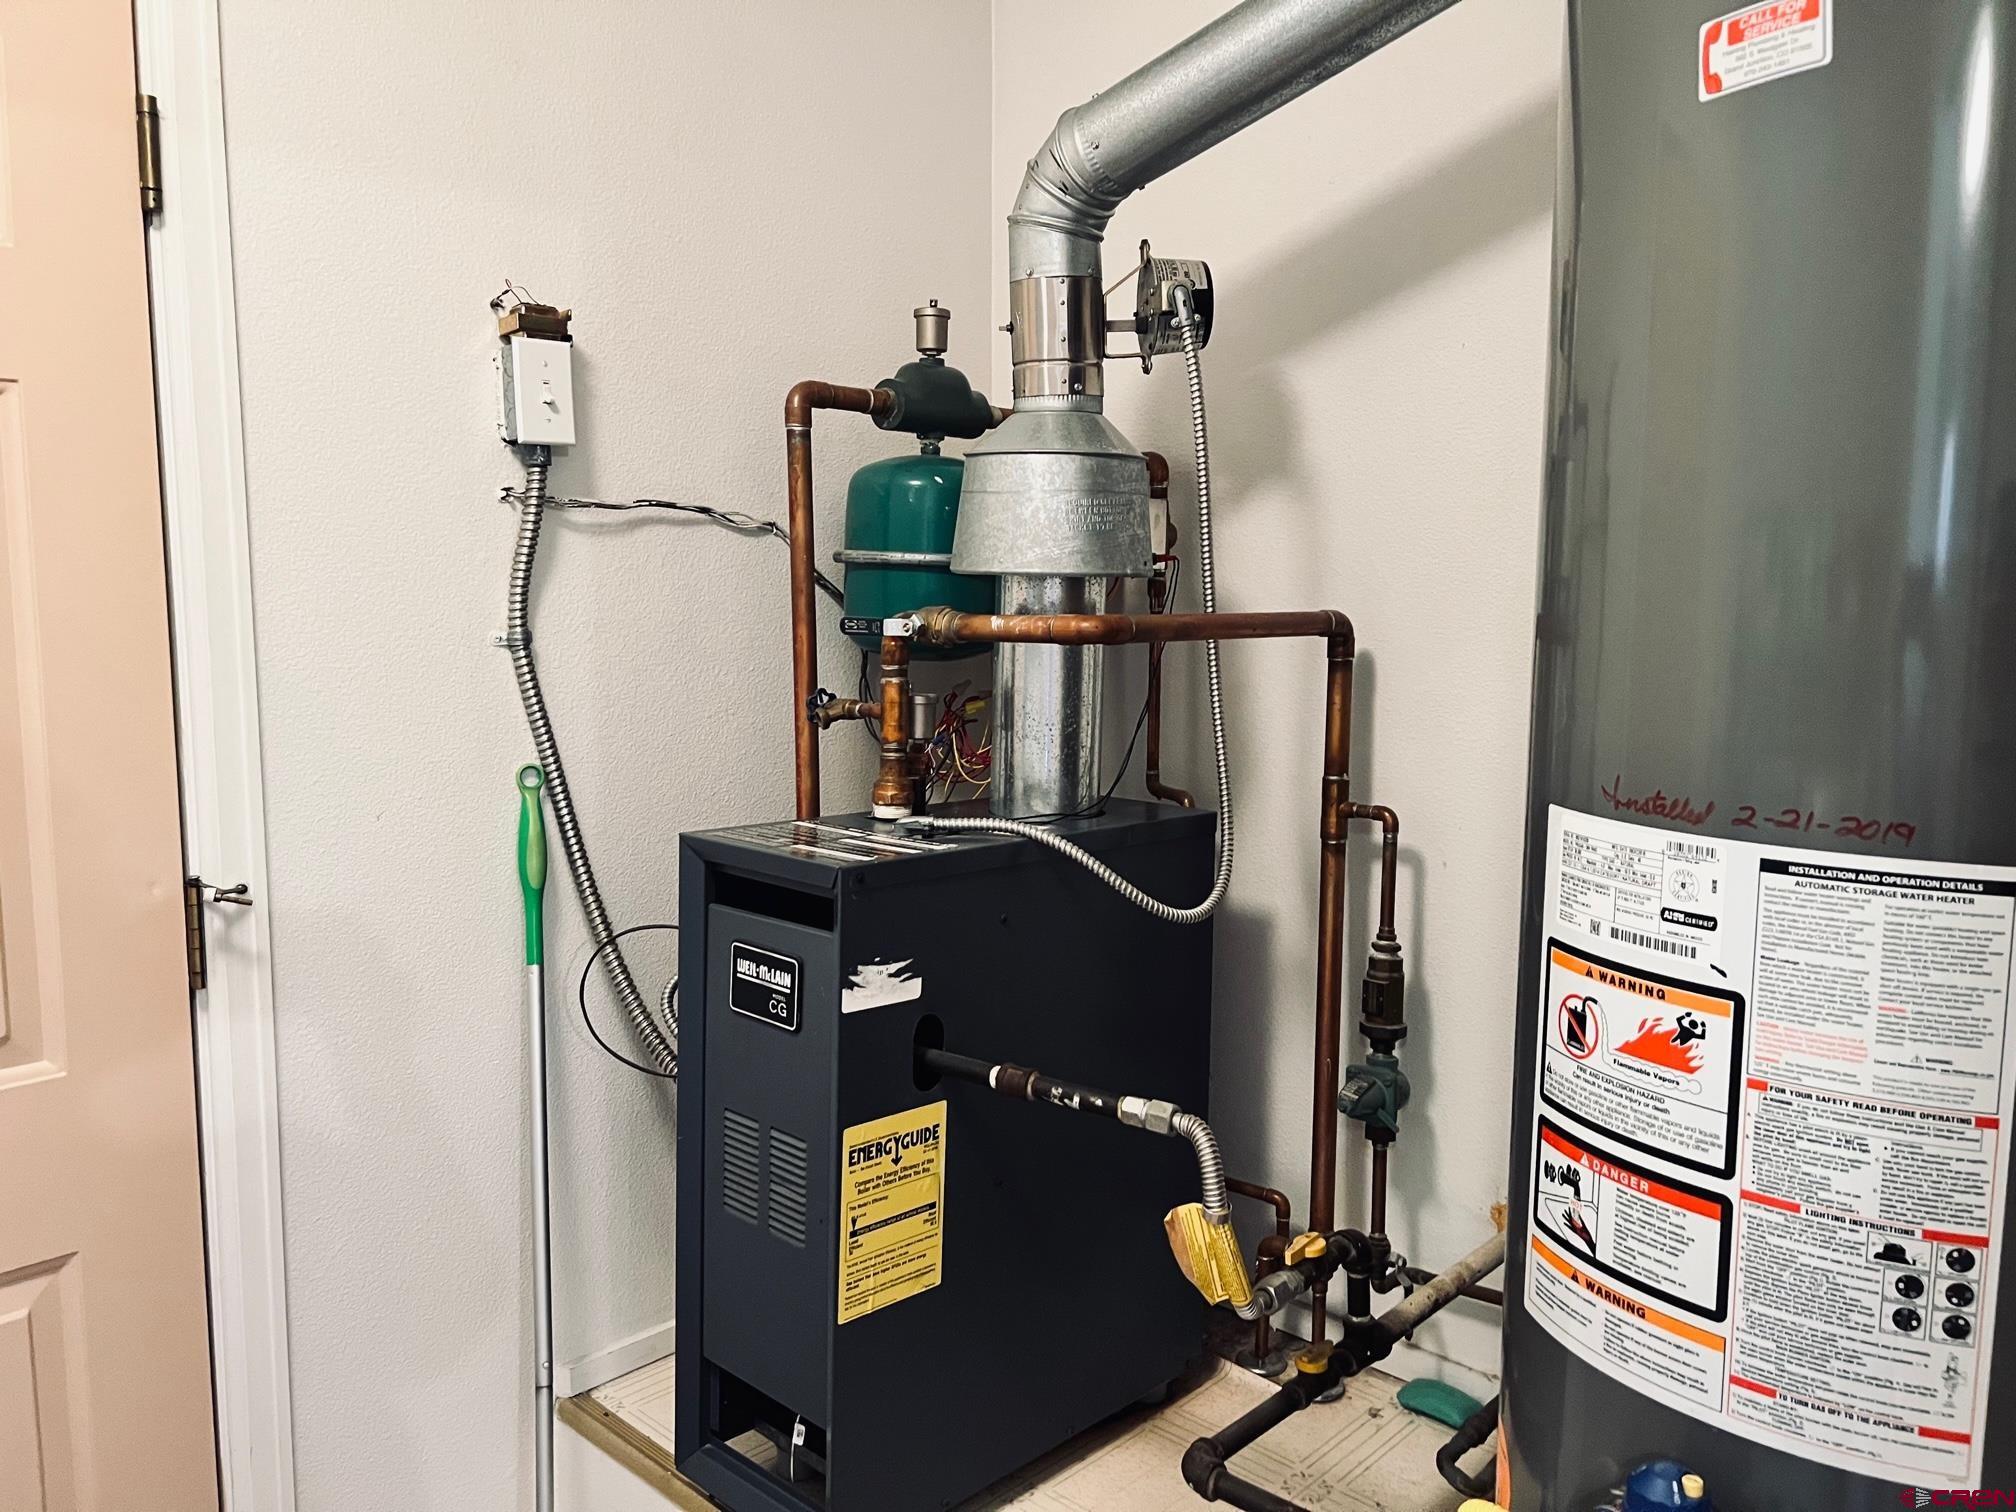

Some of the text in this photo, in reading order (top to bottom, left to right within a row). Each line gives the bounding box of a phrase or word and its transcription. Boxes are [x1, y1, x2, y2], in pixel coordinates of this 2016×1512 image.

[1739, 0, 1807, 29] CALL FOR
[1744, 12, 1802, 40] SERVICE
[1601, 774, 1714, 825] Installed
[1789, 865, 1983, 892] INSTALLATION AND OPERATION DETAILS
[1794, 880, 1975, 905] AUTOMATIC STORAGE WATER HEATER
[1599, 969, 1666, 1001] WARNING
[769, 1000, 786, 1017] CG
[1577, 1065, 1665, 1104] FIRE AND EXPLOSION HAZARD
[1613, 1058, 1680, 1086] Flammable Vapors
[1573, 1071, 1581, 1080] Can
[1604, 1087, 1623, 1098] serious
[1625, 1095, 1641, 1106] injury
[1652, 1105, 1670, 1114] death
[1770, 1085, 1972, 1126] FOR YOUR SAFETY READ BEFORE OPERATING
[849, 1123, 940, 1168] ENERGYGUIDE
[1593, 1159, 1649, 1193] DANGER
[1805, 1208, 1916, 1237] LIGHTING INSTRUCTIONS
[1586, 1278, 1646, 1319] WARNING
[1778, 1392, 1915, 1434] TO TURN GAS OFF TO THE APPLIANCE
